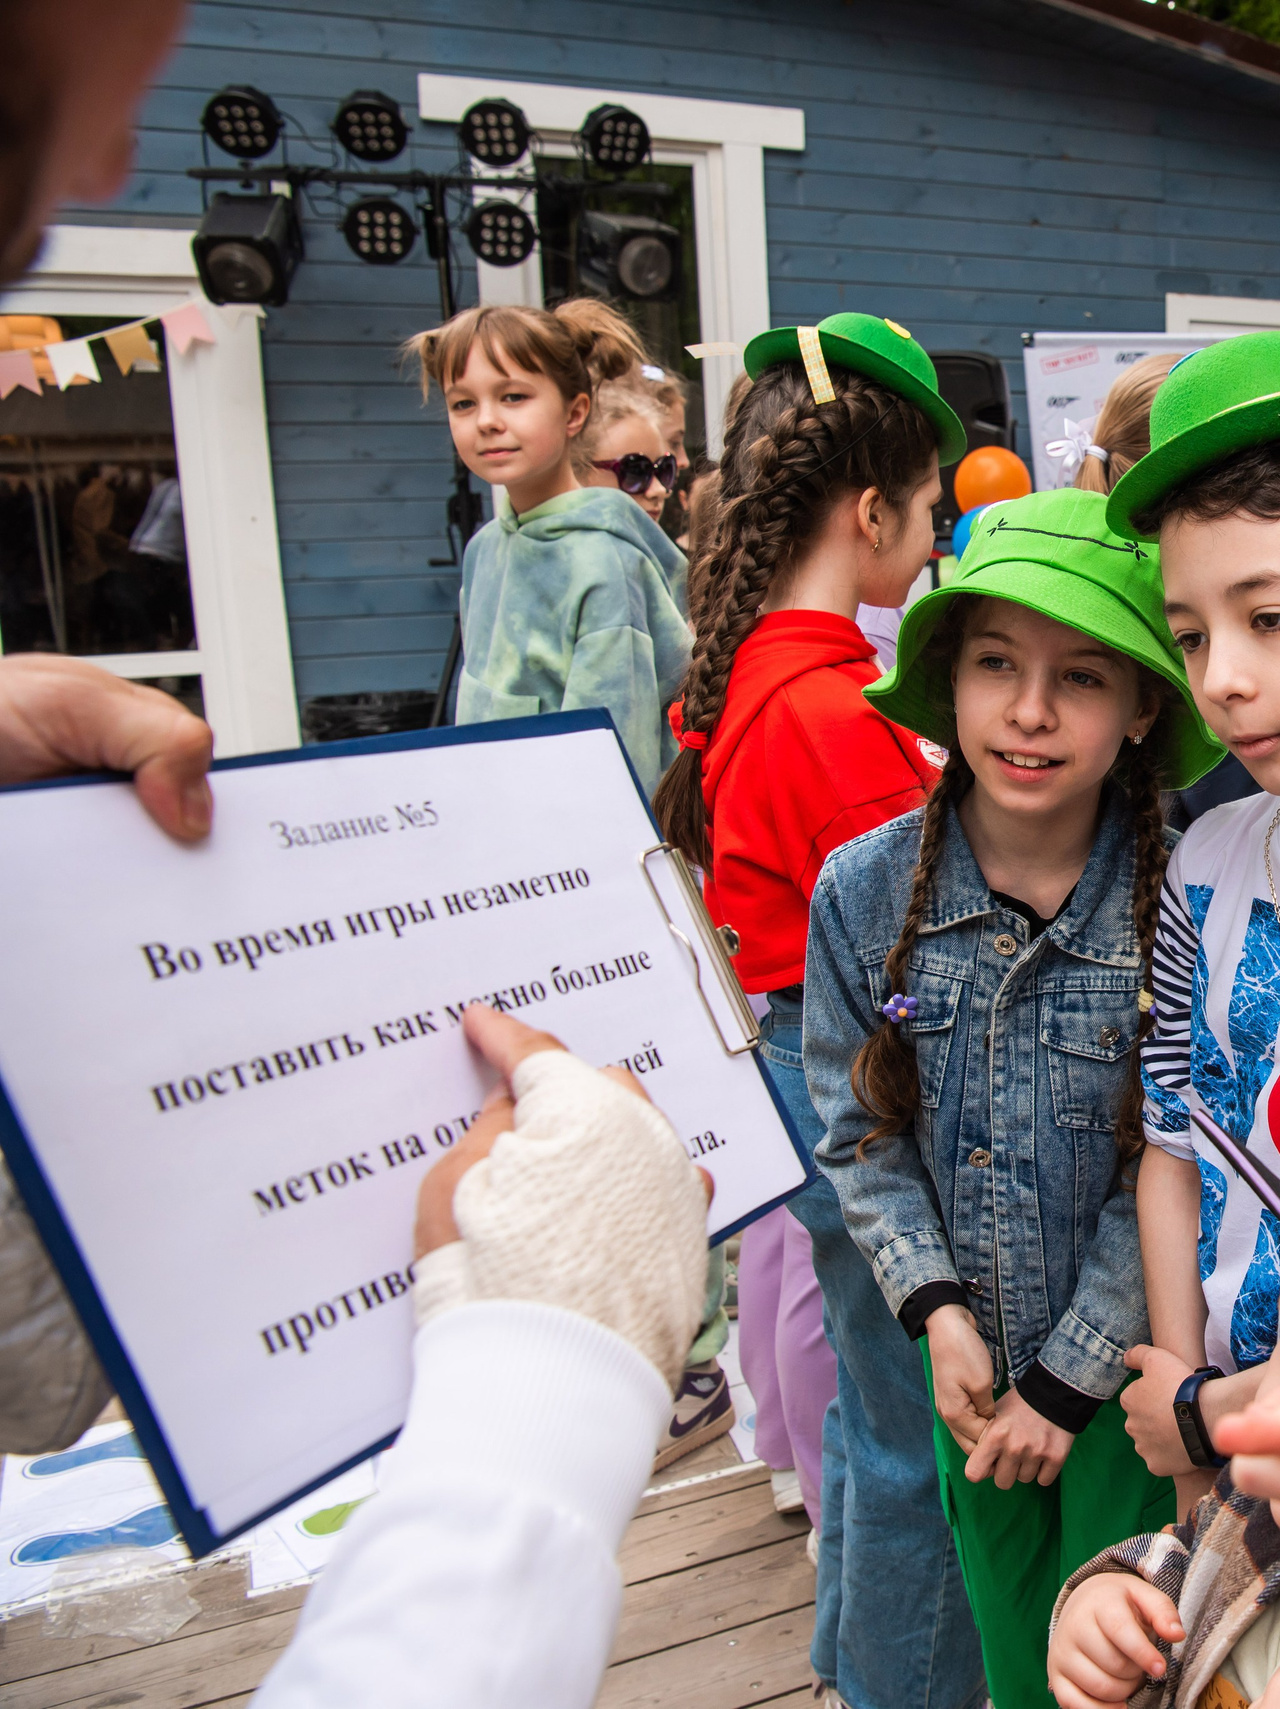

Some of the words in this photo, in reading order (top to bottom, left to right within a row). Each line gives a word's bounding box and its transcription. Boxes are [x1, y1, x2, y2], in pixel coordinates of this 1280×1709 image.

[269, 815, 390, 849] Задание
[394, 800, 439, 830] №5
[139, 941, 202, 981] Во
[212, 917, 337, 972] время
[344, 897, 436, 939] игры
[442, 865, 591, 917] незаметно
[149, 1031, 366, 1113] поставить
[372, 1010, 439, 1048] как
[444, 980, 547, 1028] мжно
[550, 949, 653, 995] больше
[251, 1151, 375, 1212] меток
[380, 1132, 428, 1168] на
